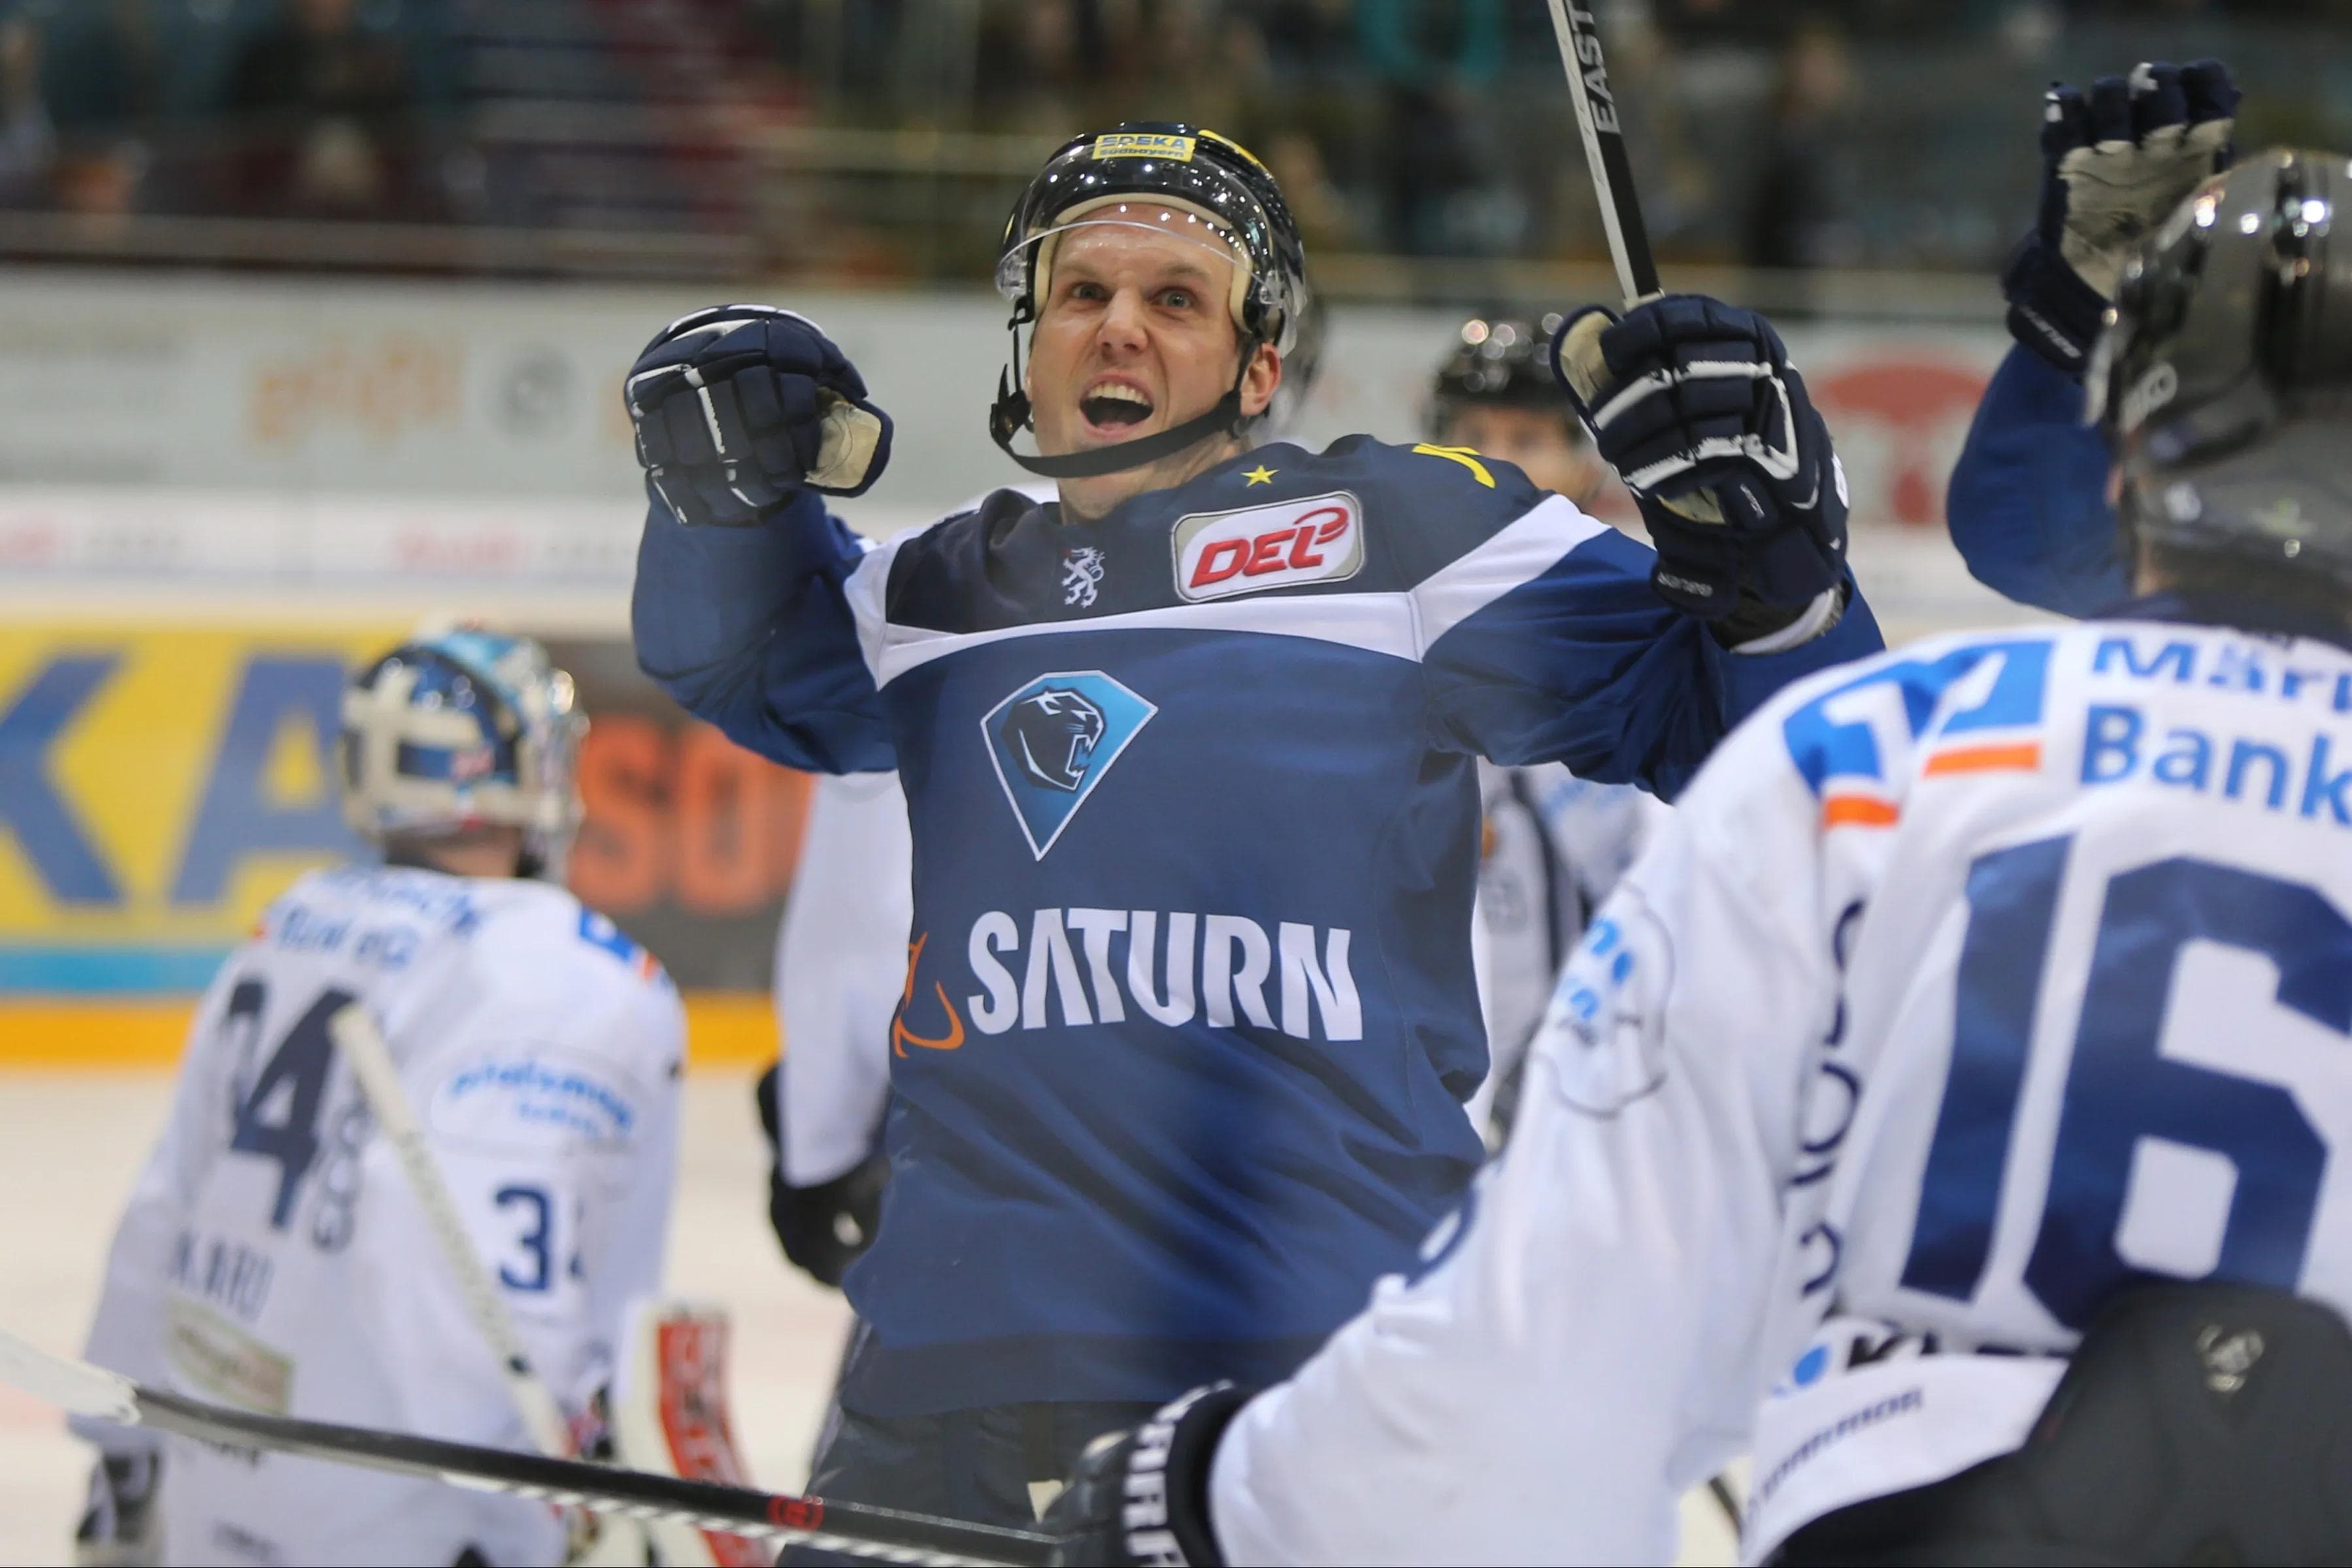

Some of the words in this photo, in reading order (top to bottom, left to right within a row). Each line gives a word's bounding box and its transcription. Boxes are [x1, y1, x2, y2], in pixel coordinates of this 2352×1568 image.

[1565, 0, 1621, 135] EAST
[1101, 135, 1186, 150] EDEKA
[1189, 506, 1350, 589] DEL
[2081, 703, 2352, 826] Bank
[967, 907, 1363, 1041] SATURN
[1897, 832, 2352, 1334] 16
